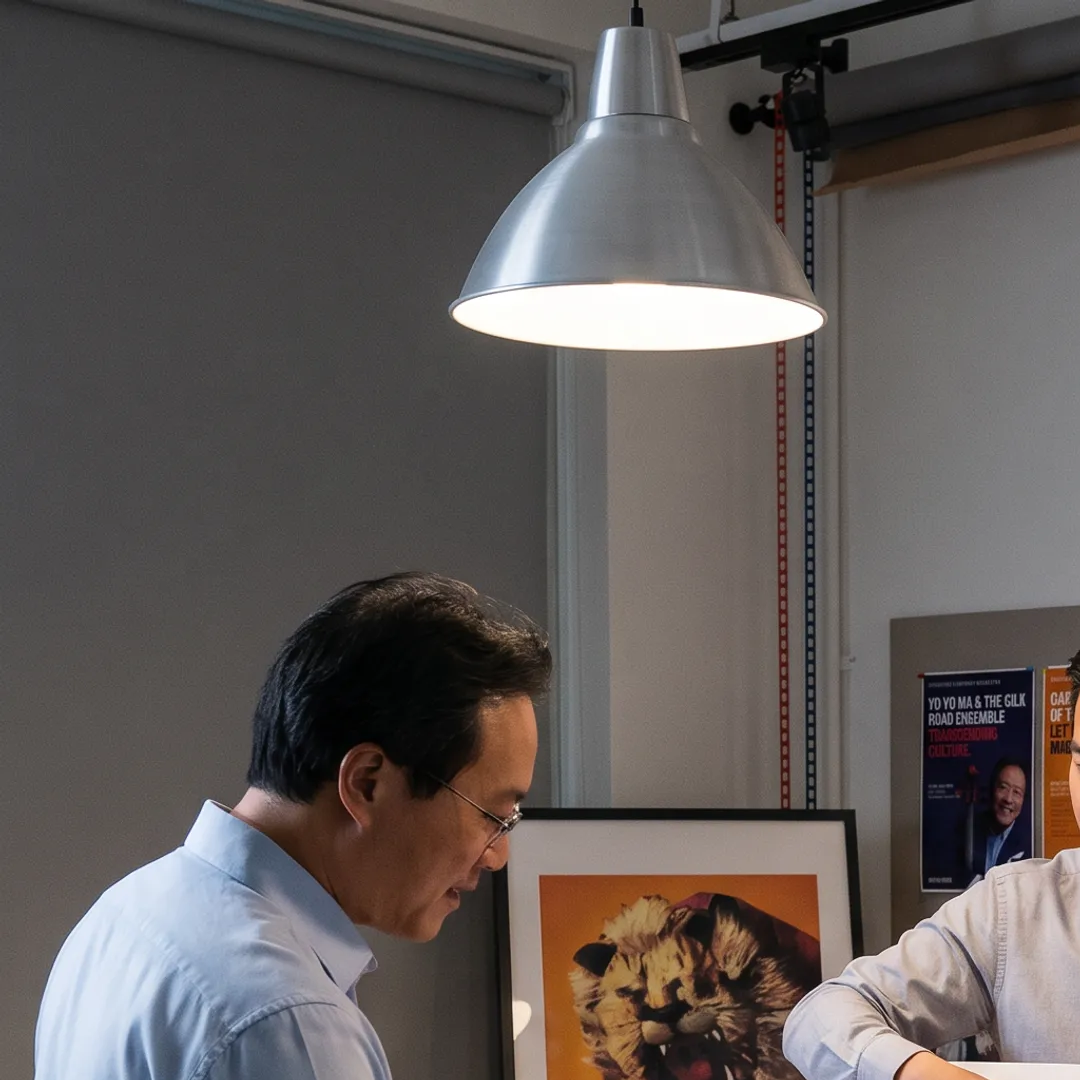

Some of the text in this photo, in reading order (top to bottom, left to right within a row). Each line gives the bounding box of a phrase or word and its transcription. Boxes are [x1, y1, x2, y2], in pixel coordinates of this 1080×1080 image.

[942, 696, 956, 710] YO
[958, 696, 972, 710] MA
[974, 696, 982, 709] &
[984, 694, 1002, 708] THE
[928, 712, 953, 726] ROAD
[1050, 724, 1067, 738] LET
